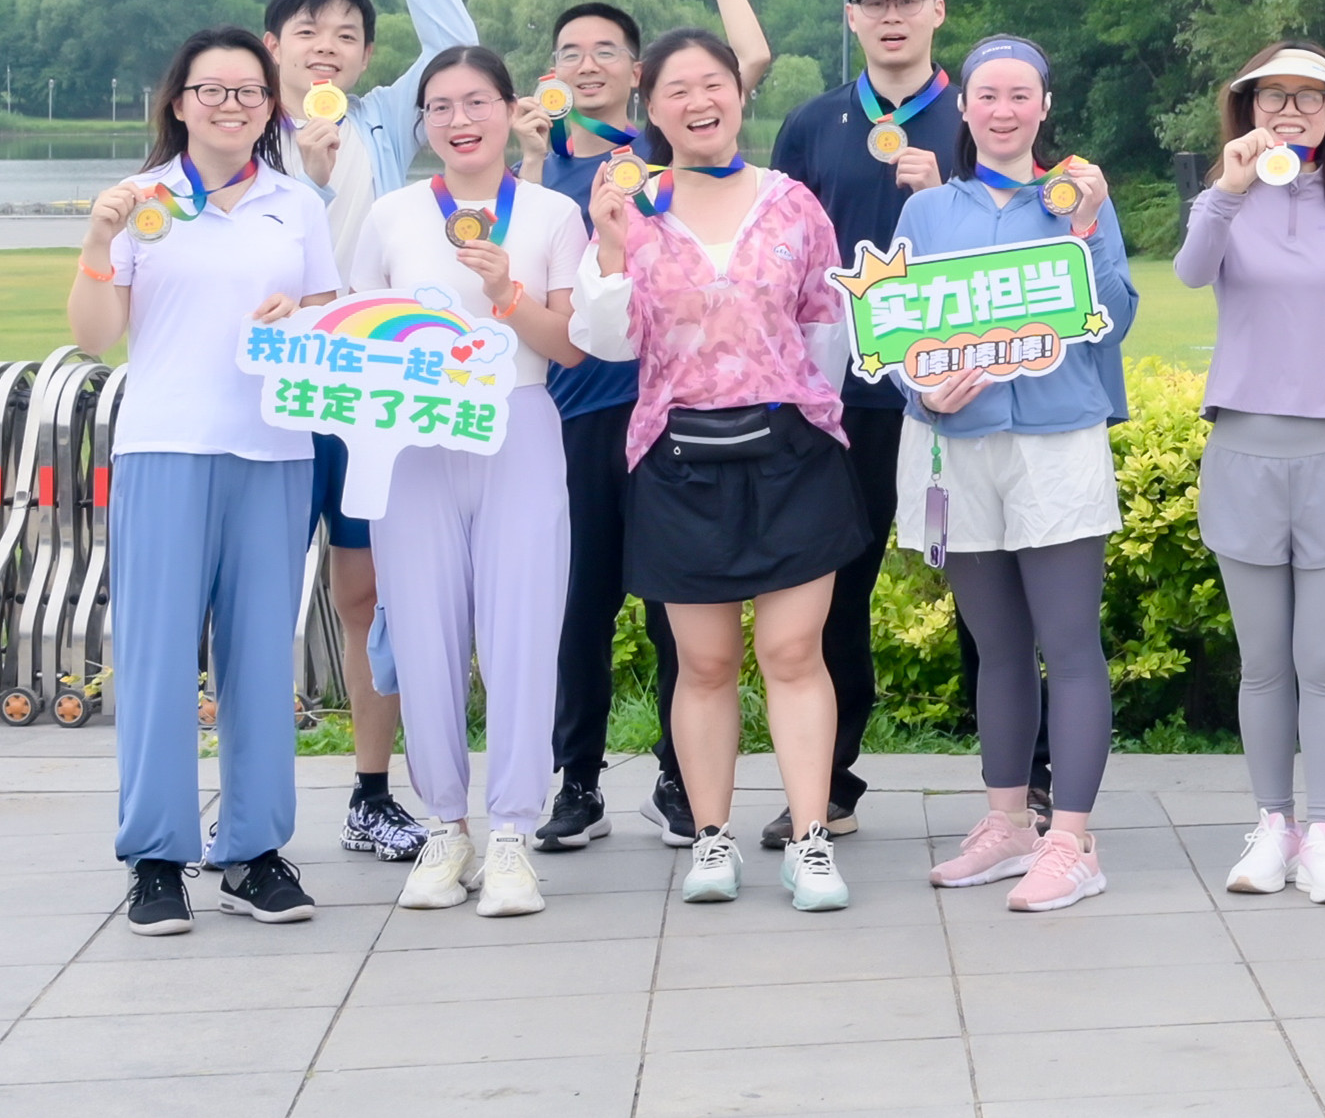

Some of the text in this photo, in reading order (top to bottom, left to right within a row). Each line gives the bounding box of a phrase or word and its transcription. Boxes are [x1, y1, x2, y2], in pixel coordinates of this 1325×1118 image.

[867, 259, 1076, 338] 实力担当
[247, 327, 445, 386] 我们在一起
[274, 378, 496, 442] 注定了不起
